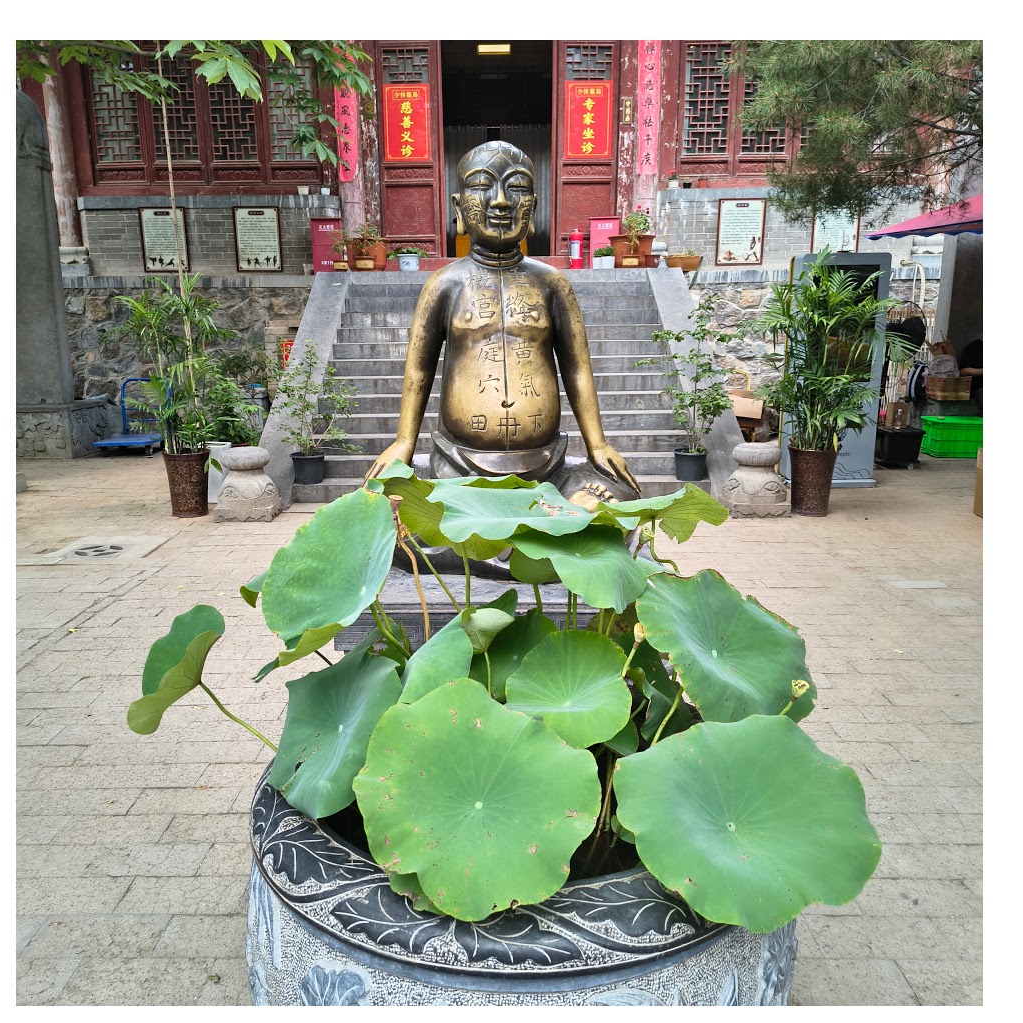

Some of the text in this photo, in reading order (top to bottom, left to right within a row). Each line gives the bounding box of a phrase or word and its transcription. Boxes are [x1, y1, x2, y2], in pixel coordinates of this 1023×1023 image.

[400, 100, 415, 157] 慈善义诊
[581, 98, 596, 154] 专家坐诊
